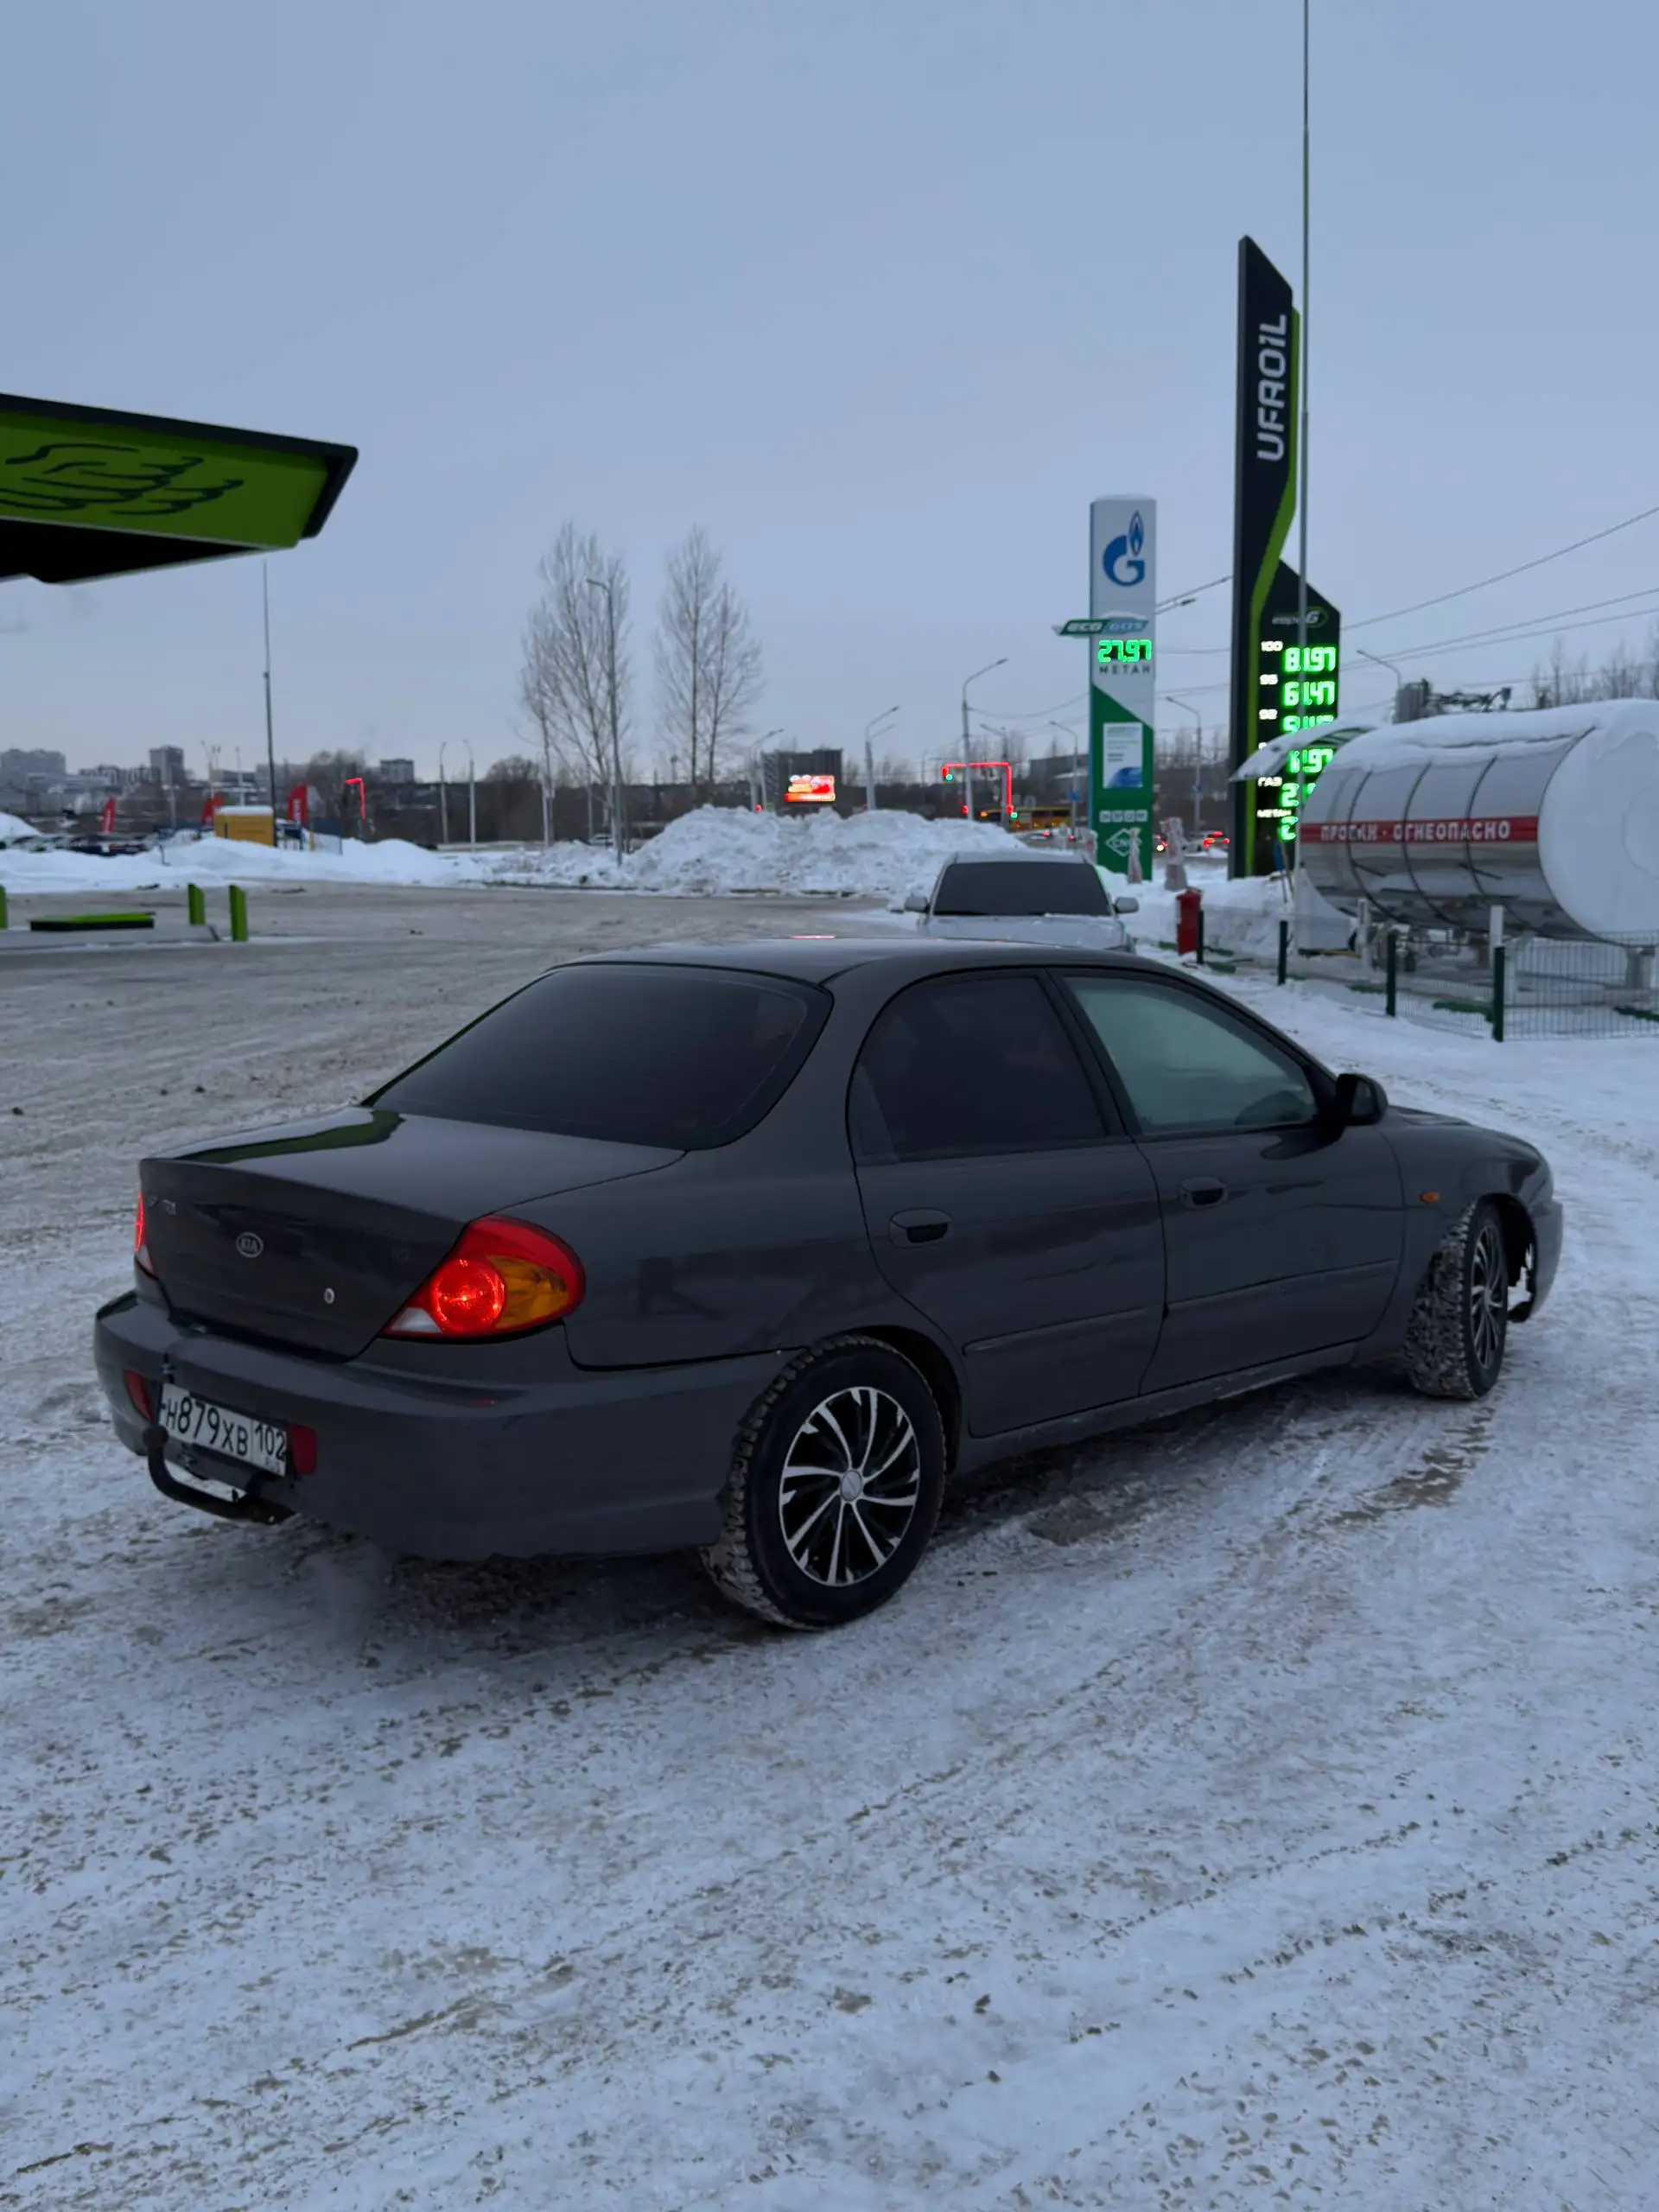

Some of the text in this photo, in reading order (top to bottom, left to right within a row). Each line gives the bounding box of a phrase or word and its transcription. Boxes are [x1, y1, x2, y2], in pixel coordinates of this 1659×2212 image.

[1256, 315, 1287, 461] UFAOIL
[1261, 640, 1283, 652] 100
[1099, 664, 1150, 674] МЕТАН
[1393, 820, 1510, 841] ОГНЕОПАСНО
